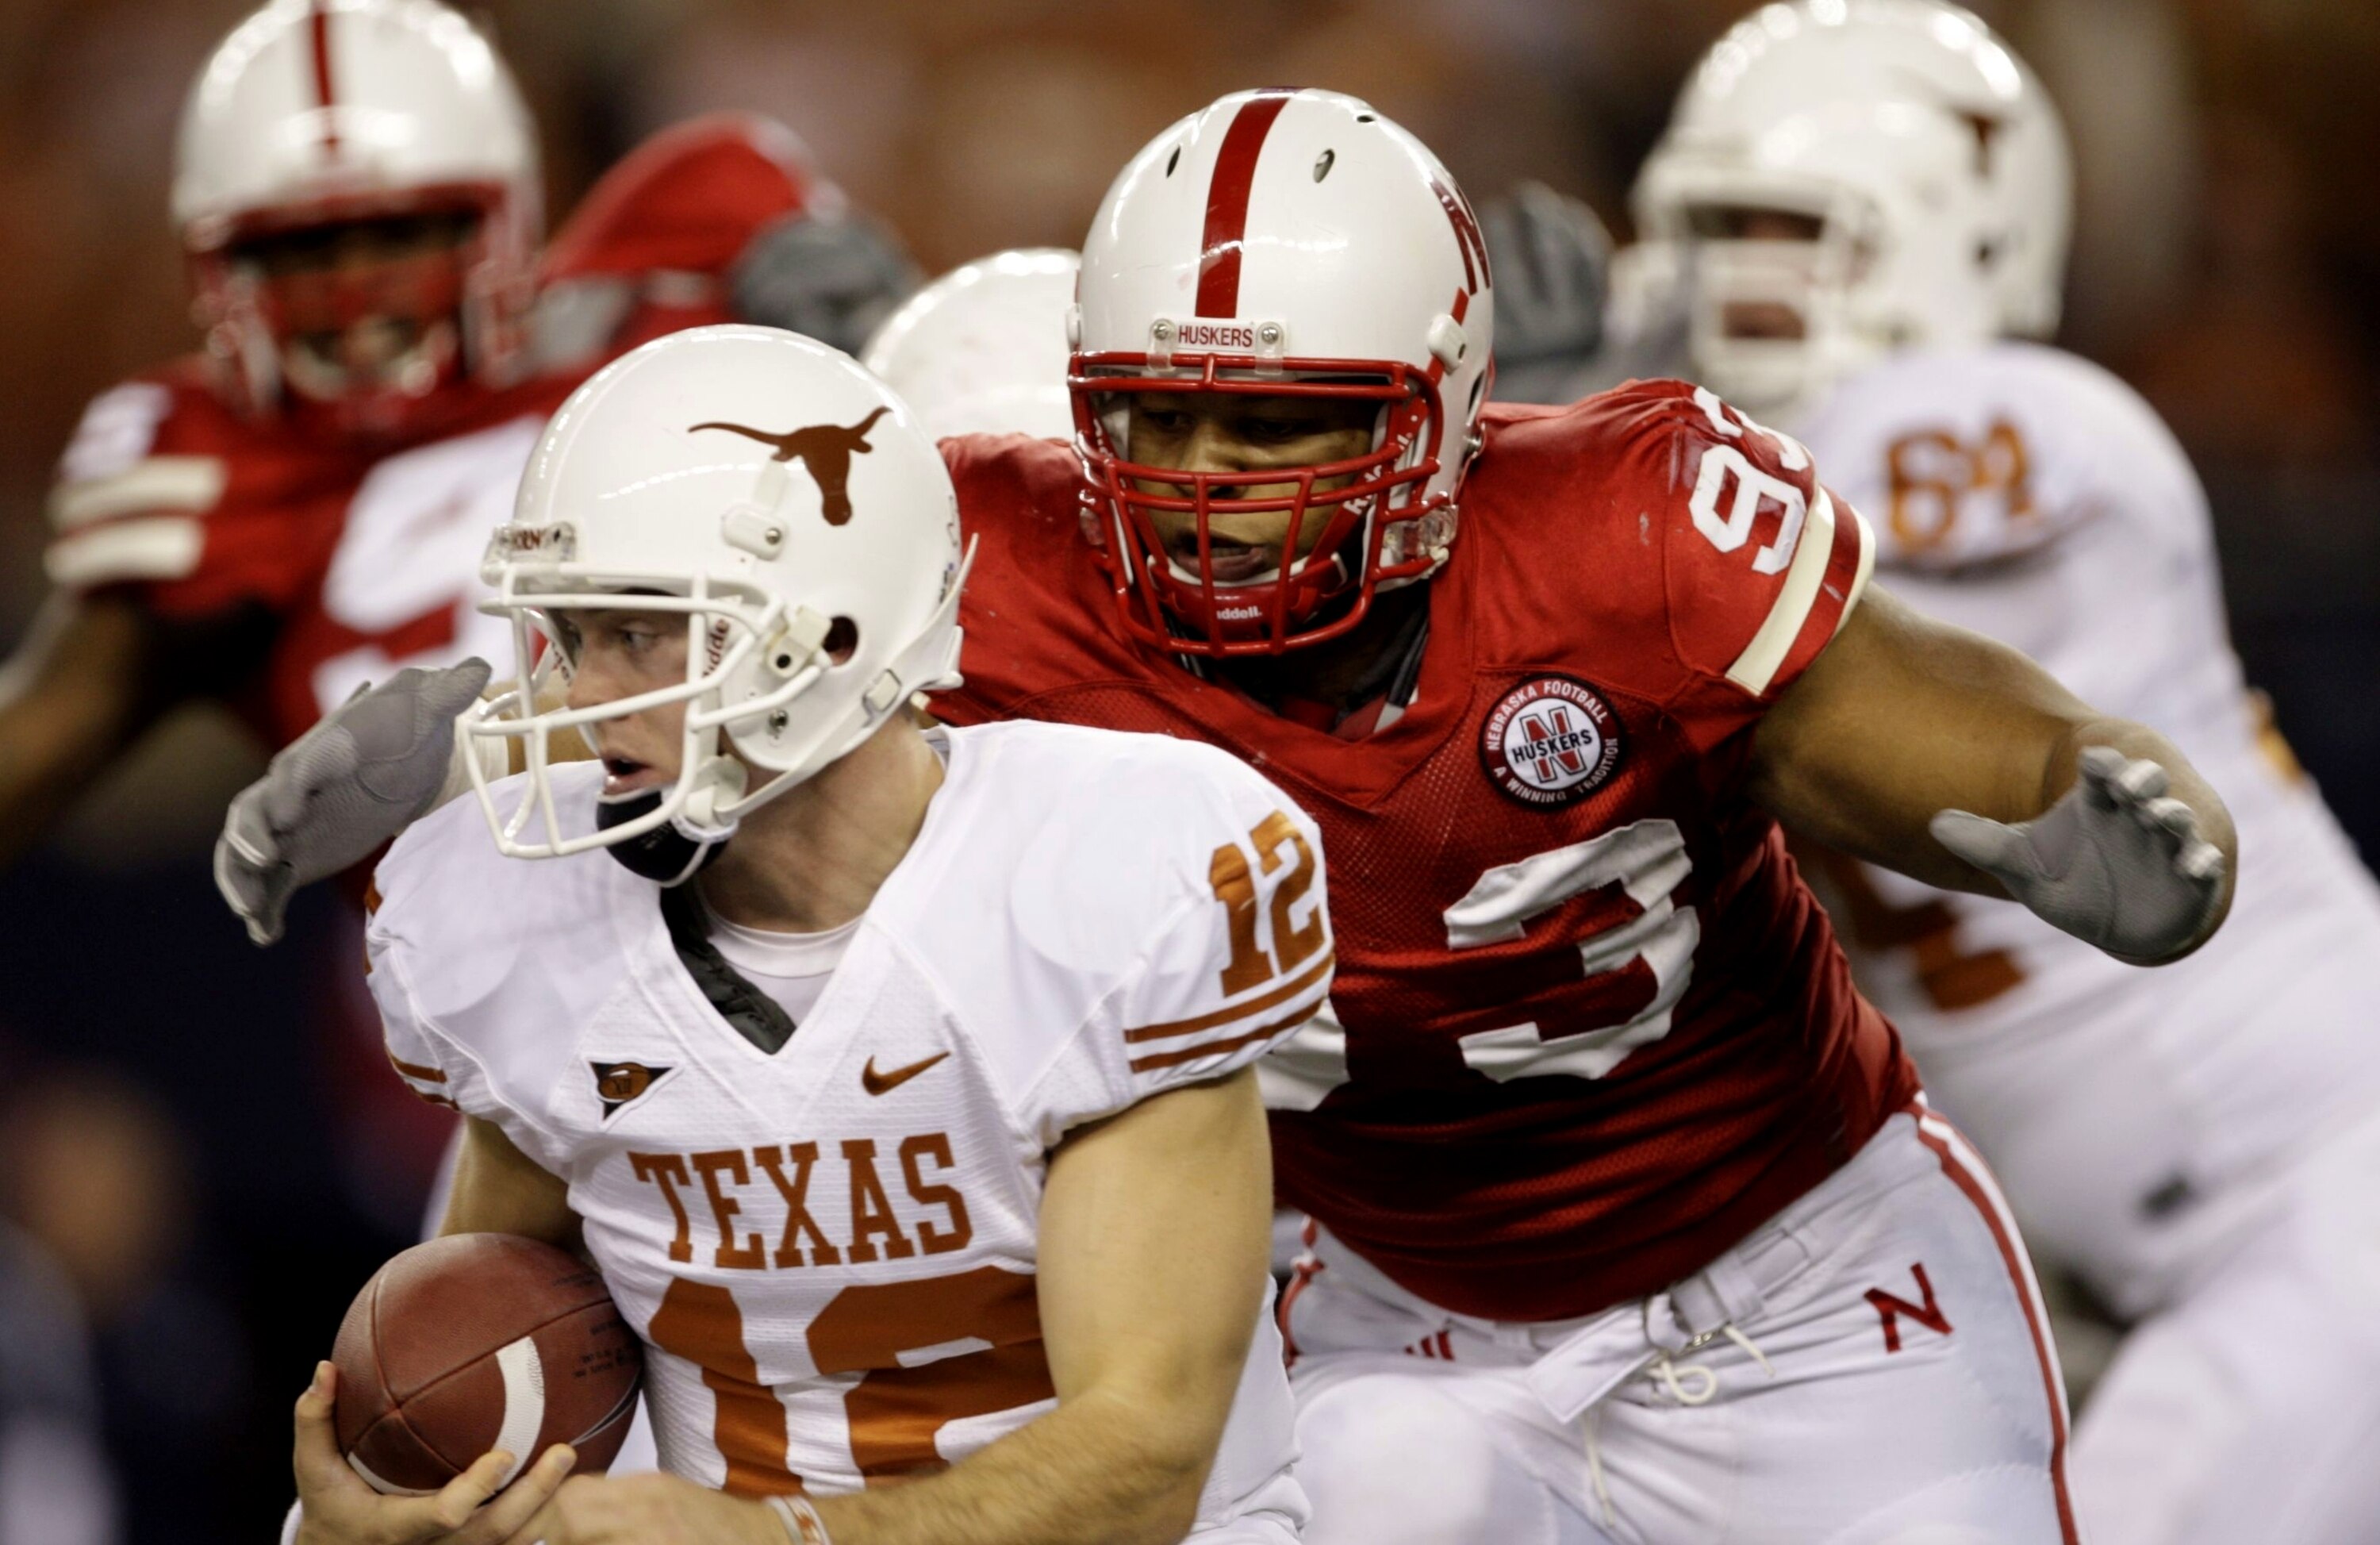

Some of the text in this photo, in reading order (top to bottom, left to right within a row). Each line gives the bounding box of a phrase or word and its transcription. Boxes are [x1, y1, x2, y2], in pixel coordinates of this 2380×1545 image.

[1178, 325, 1253, 348] HUSKERS
[1487, 681, 1608, 751] NEBRASKA FOOTBALL
[1511, 728, 1593, 764] HUSKERS
[1493, 738, 1619, 804] A WINNING TRADITION
[1207, 809, 1326, 998] 12
[627, 1132, 973, 1270] TEXAS
[1863, 1259, 1955, 1355] N
